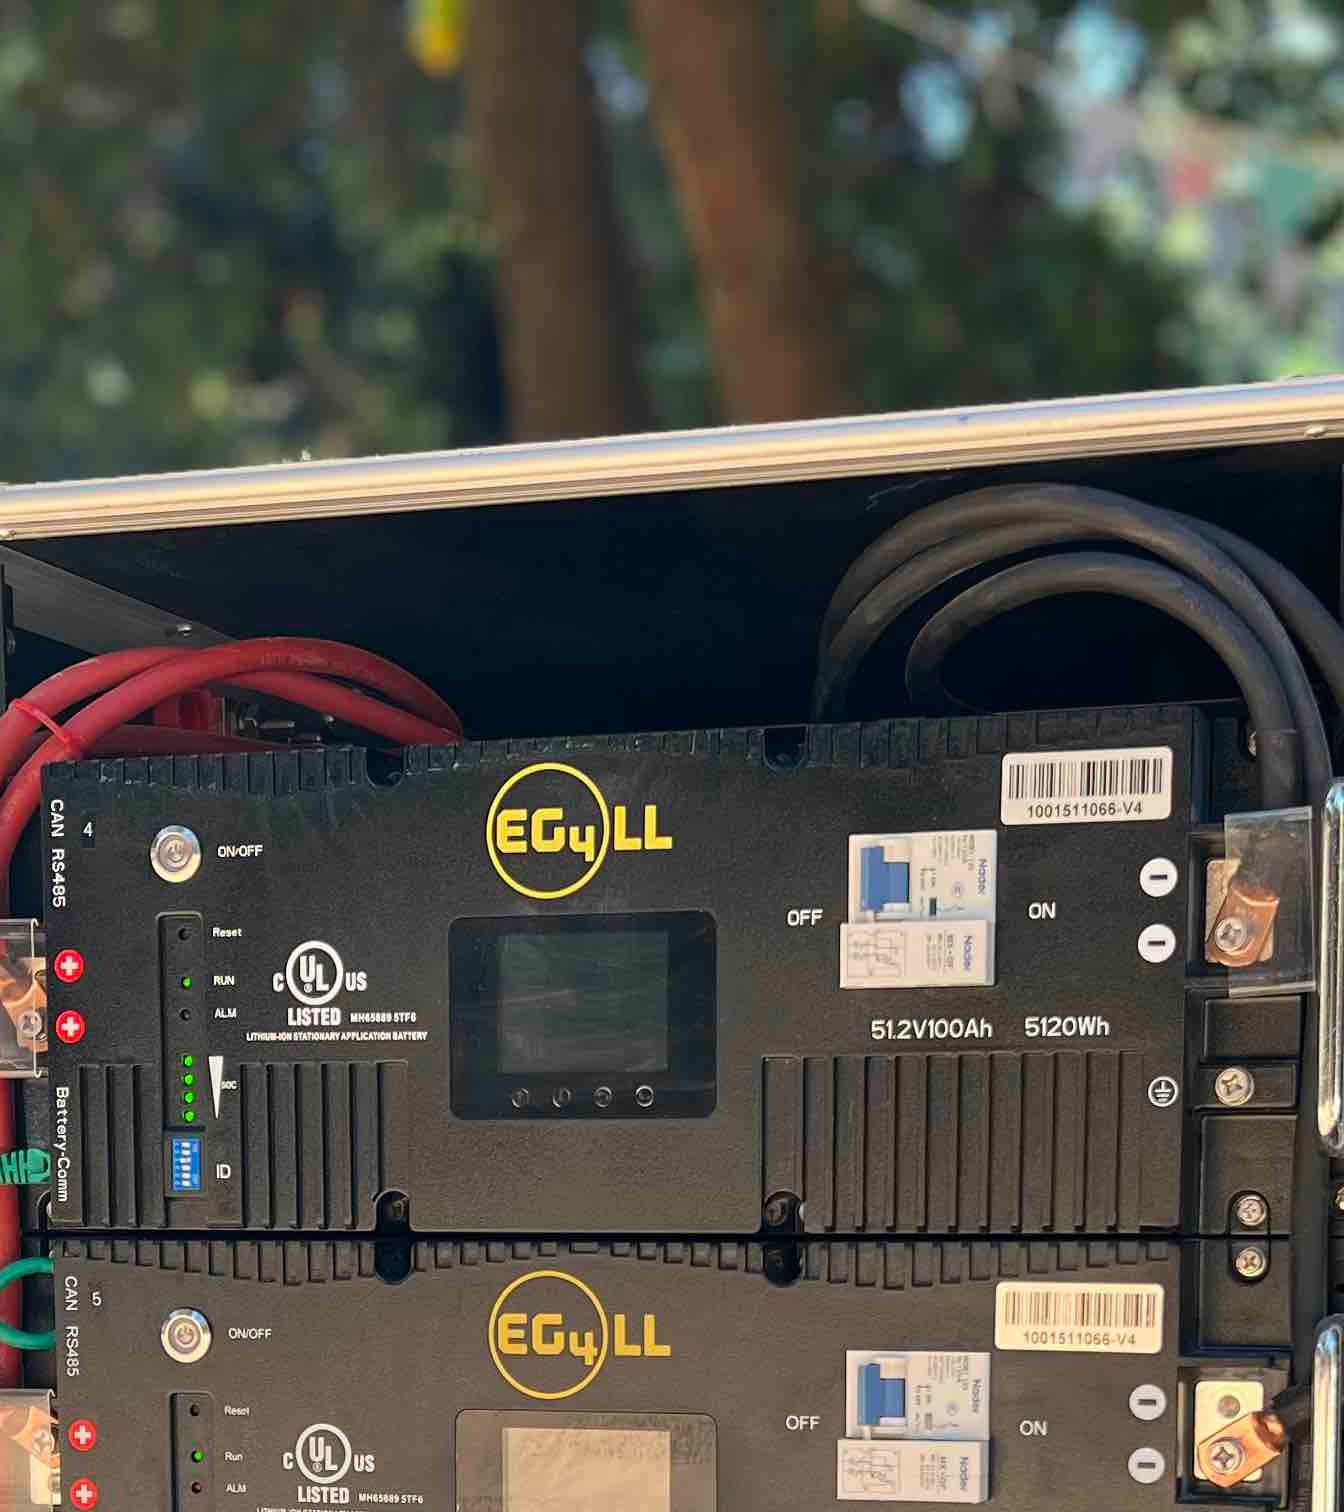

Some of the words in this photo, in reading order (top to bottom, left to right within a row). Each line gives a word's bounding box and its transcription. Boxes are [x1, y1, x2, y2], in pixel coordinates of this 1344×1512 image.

[50, 799, 65, 837] CAN
[1027, 801, 1143, 818] 1001511066-V4
[83, 821, 94, 837] 4
[613, 804, 673, 850] LL
[217, 844, 264, 858] ON/OFF
[51, 848, 66, 908] RS485
[787, 908, 823, 926] OFF
[1028, 901, 1056, 919] ON
[212, 927, 242, 938] Reset
[213, 975, 235, 986] RUN
[345, 971, 368, 991] US
[214, 1008, 237, 1018] ALM
[287, 1007, 342, 1026] LISTED
[1024, 1016, 1110, 1038] 5120Wh
[246, 1032, 293, 1041] LITHIUM-ION
[293, 1032, 340, 1041] STATIONARY
[341, 1032, 391, 1041] APPLICATION
[392, 1031, 428, 1041] BATTERY
[53, 1087, 71, 1202] Battery-Comm
[216, 1163, 232, 1180] ID
[64, 1275, 79, 1312] CAN
[90, 1291, 102, 1306] 5
[228, 1328, 273, 1340] ON/OFF
[613, 1313, 672, 1356] LL
[1023, 1331, 1137, 1346] 1001511066-V4
[66, 1326, 80, 1377] RS485
[224, 1406, 250, 1416] Reset
[785, 1415, 821, 1431] OFF
[1019, 1420, 1047, 1436] ON
[224, 1452, 244, 1461] Run
[353, 1454, 376, 1472] US
[226, 1483, 247, 1493] ALM
[297, 1485, 350, 1504] LISTED
